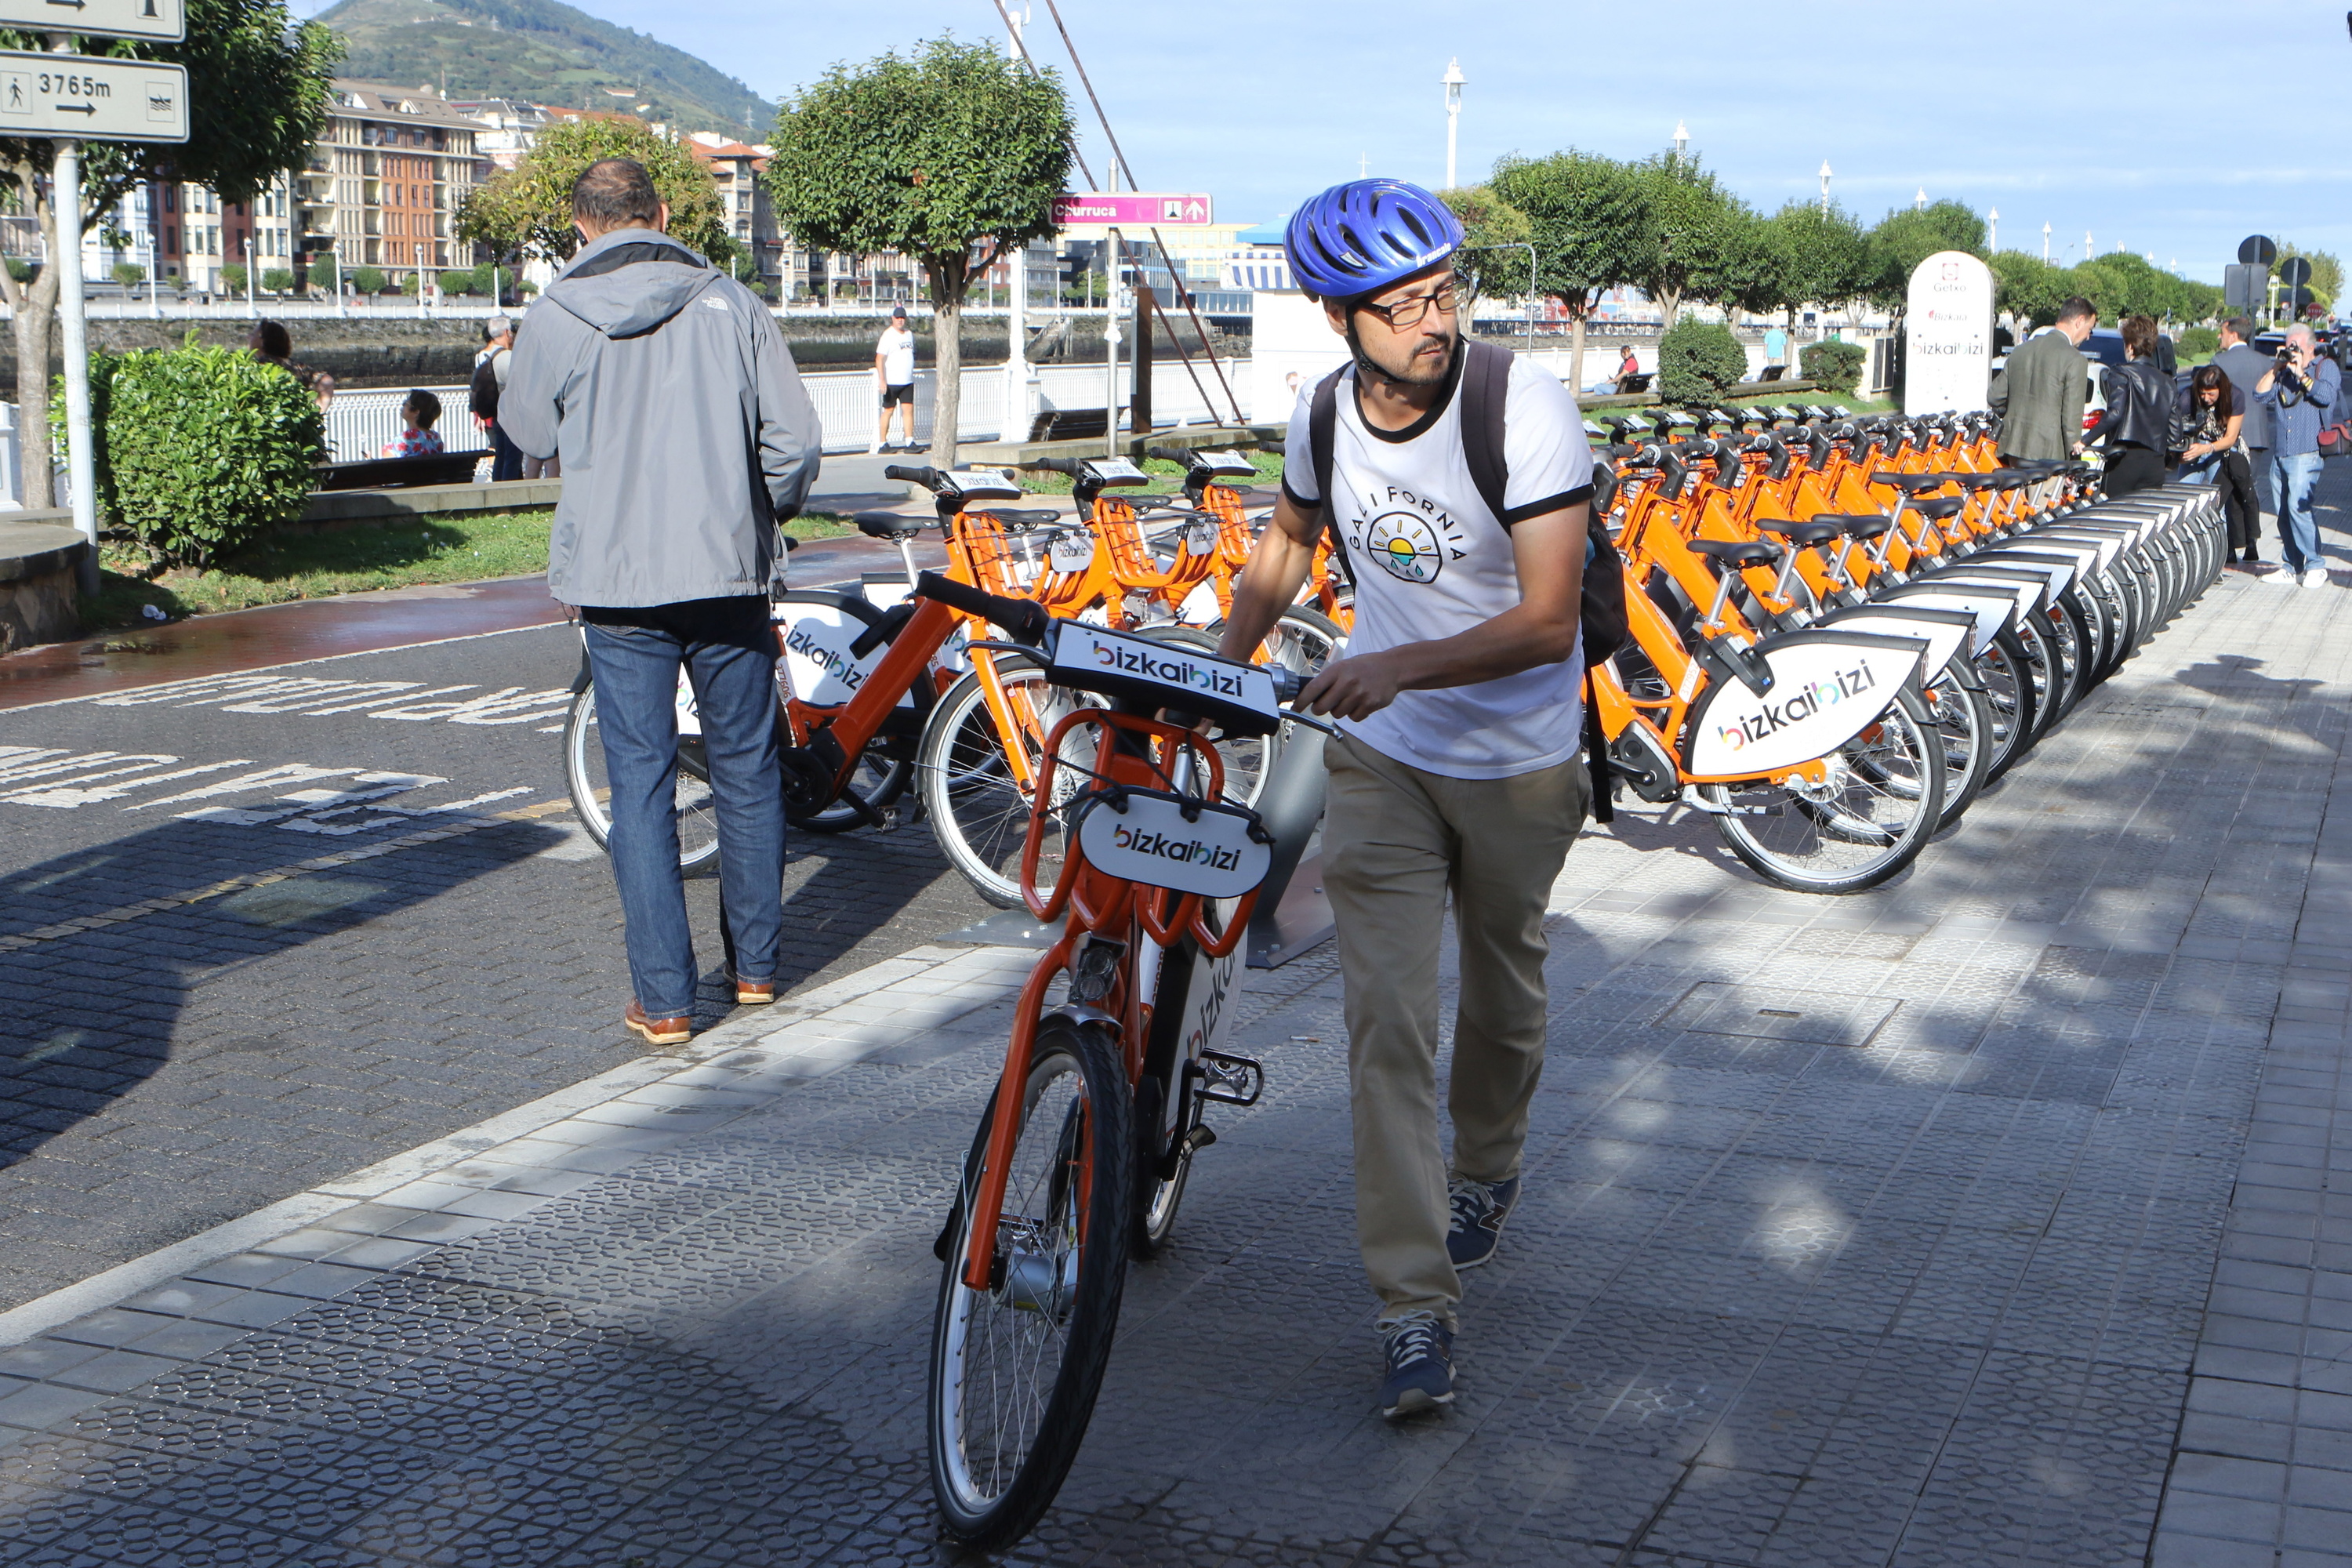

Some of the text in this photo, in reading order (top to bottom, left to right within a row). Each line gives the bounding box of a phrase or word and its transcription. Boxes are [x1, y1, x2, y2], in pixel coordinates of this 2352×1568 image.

[39, 74, 111, 97] 3765m
[1416, 242, 1451, 267] brancale
[1933, 282, 1966, 292] Getxo
[1913, 343, 1983, 354] bizkaibizi
[775, 664, 791, 698] 377606
[1094, 641, 1242, 697] bizkaibizi
[1718, 659, 1875, 751] bizkaibizi
[1114, 824, 1241, 871] bizkaibizi
